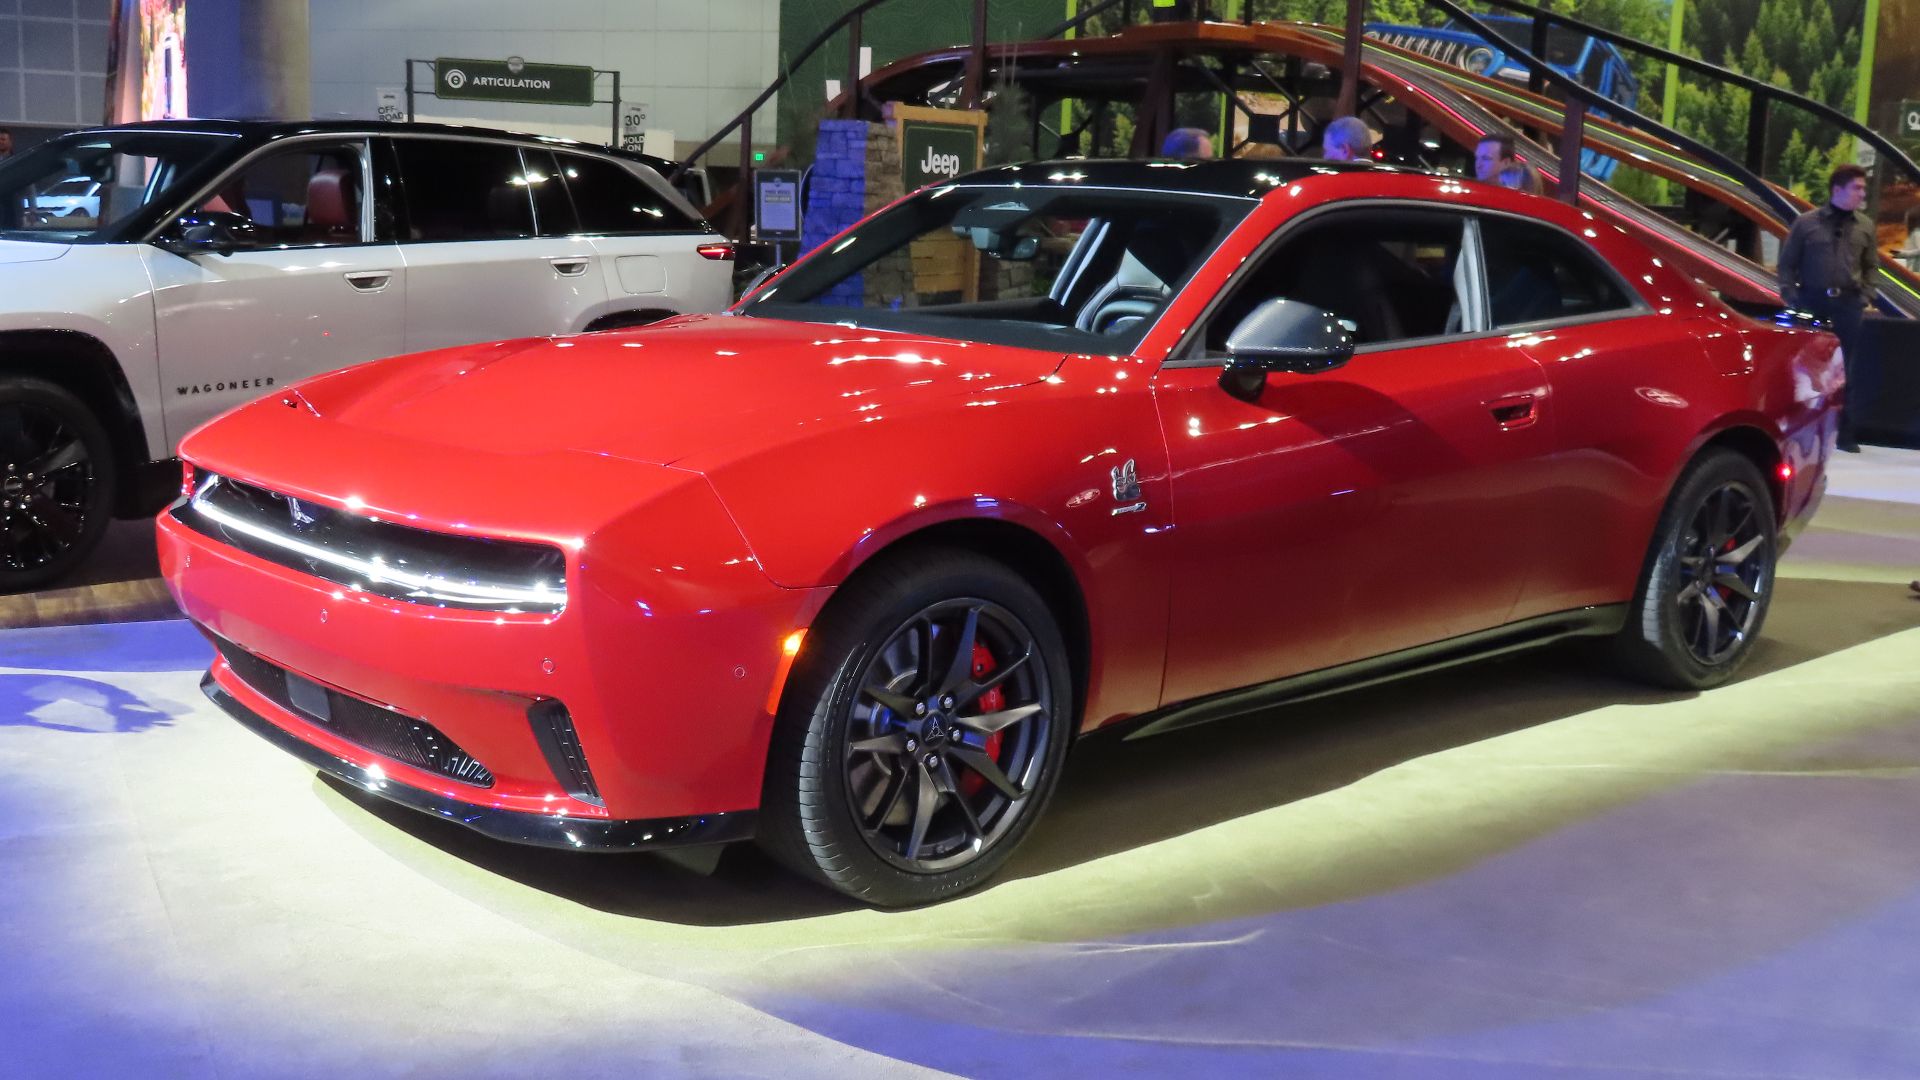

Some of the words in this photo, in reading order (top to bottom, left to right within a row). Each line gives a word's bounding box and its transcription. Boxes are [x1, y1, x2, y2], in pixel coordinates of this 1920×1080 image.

[473, 77, 550, 89] ARTICULATION
[379, 112, 403, 121] ROAD
[623, 135, 645, 144] HOLD
[921, 146, 960, 178] Jeep
[177, 377, 274, 395] WAGONEER
